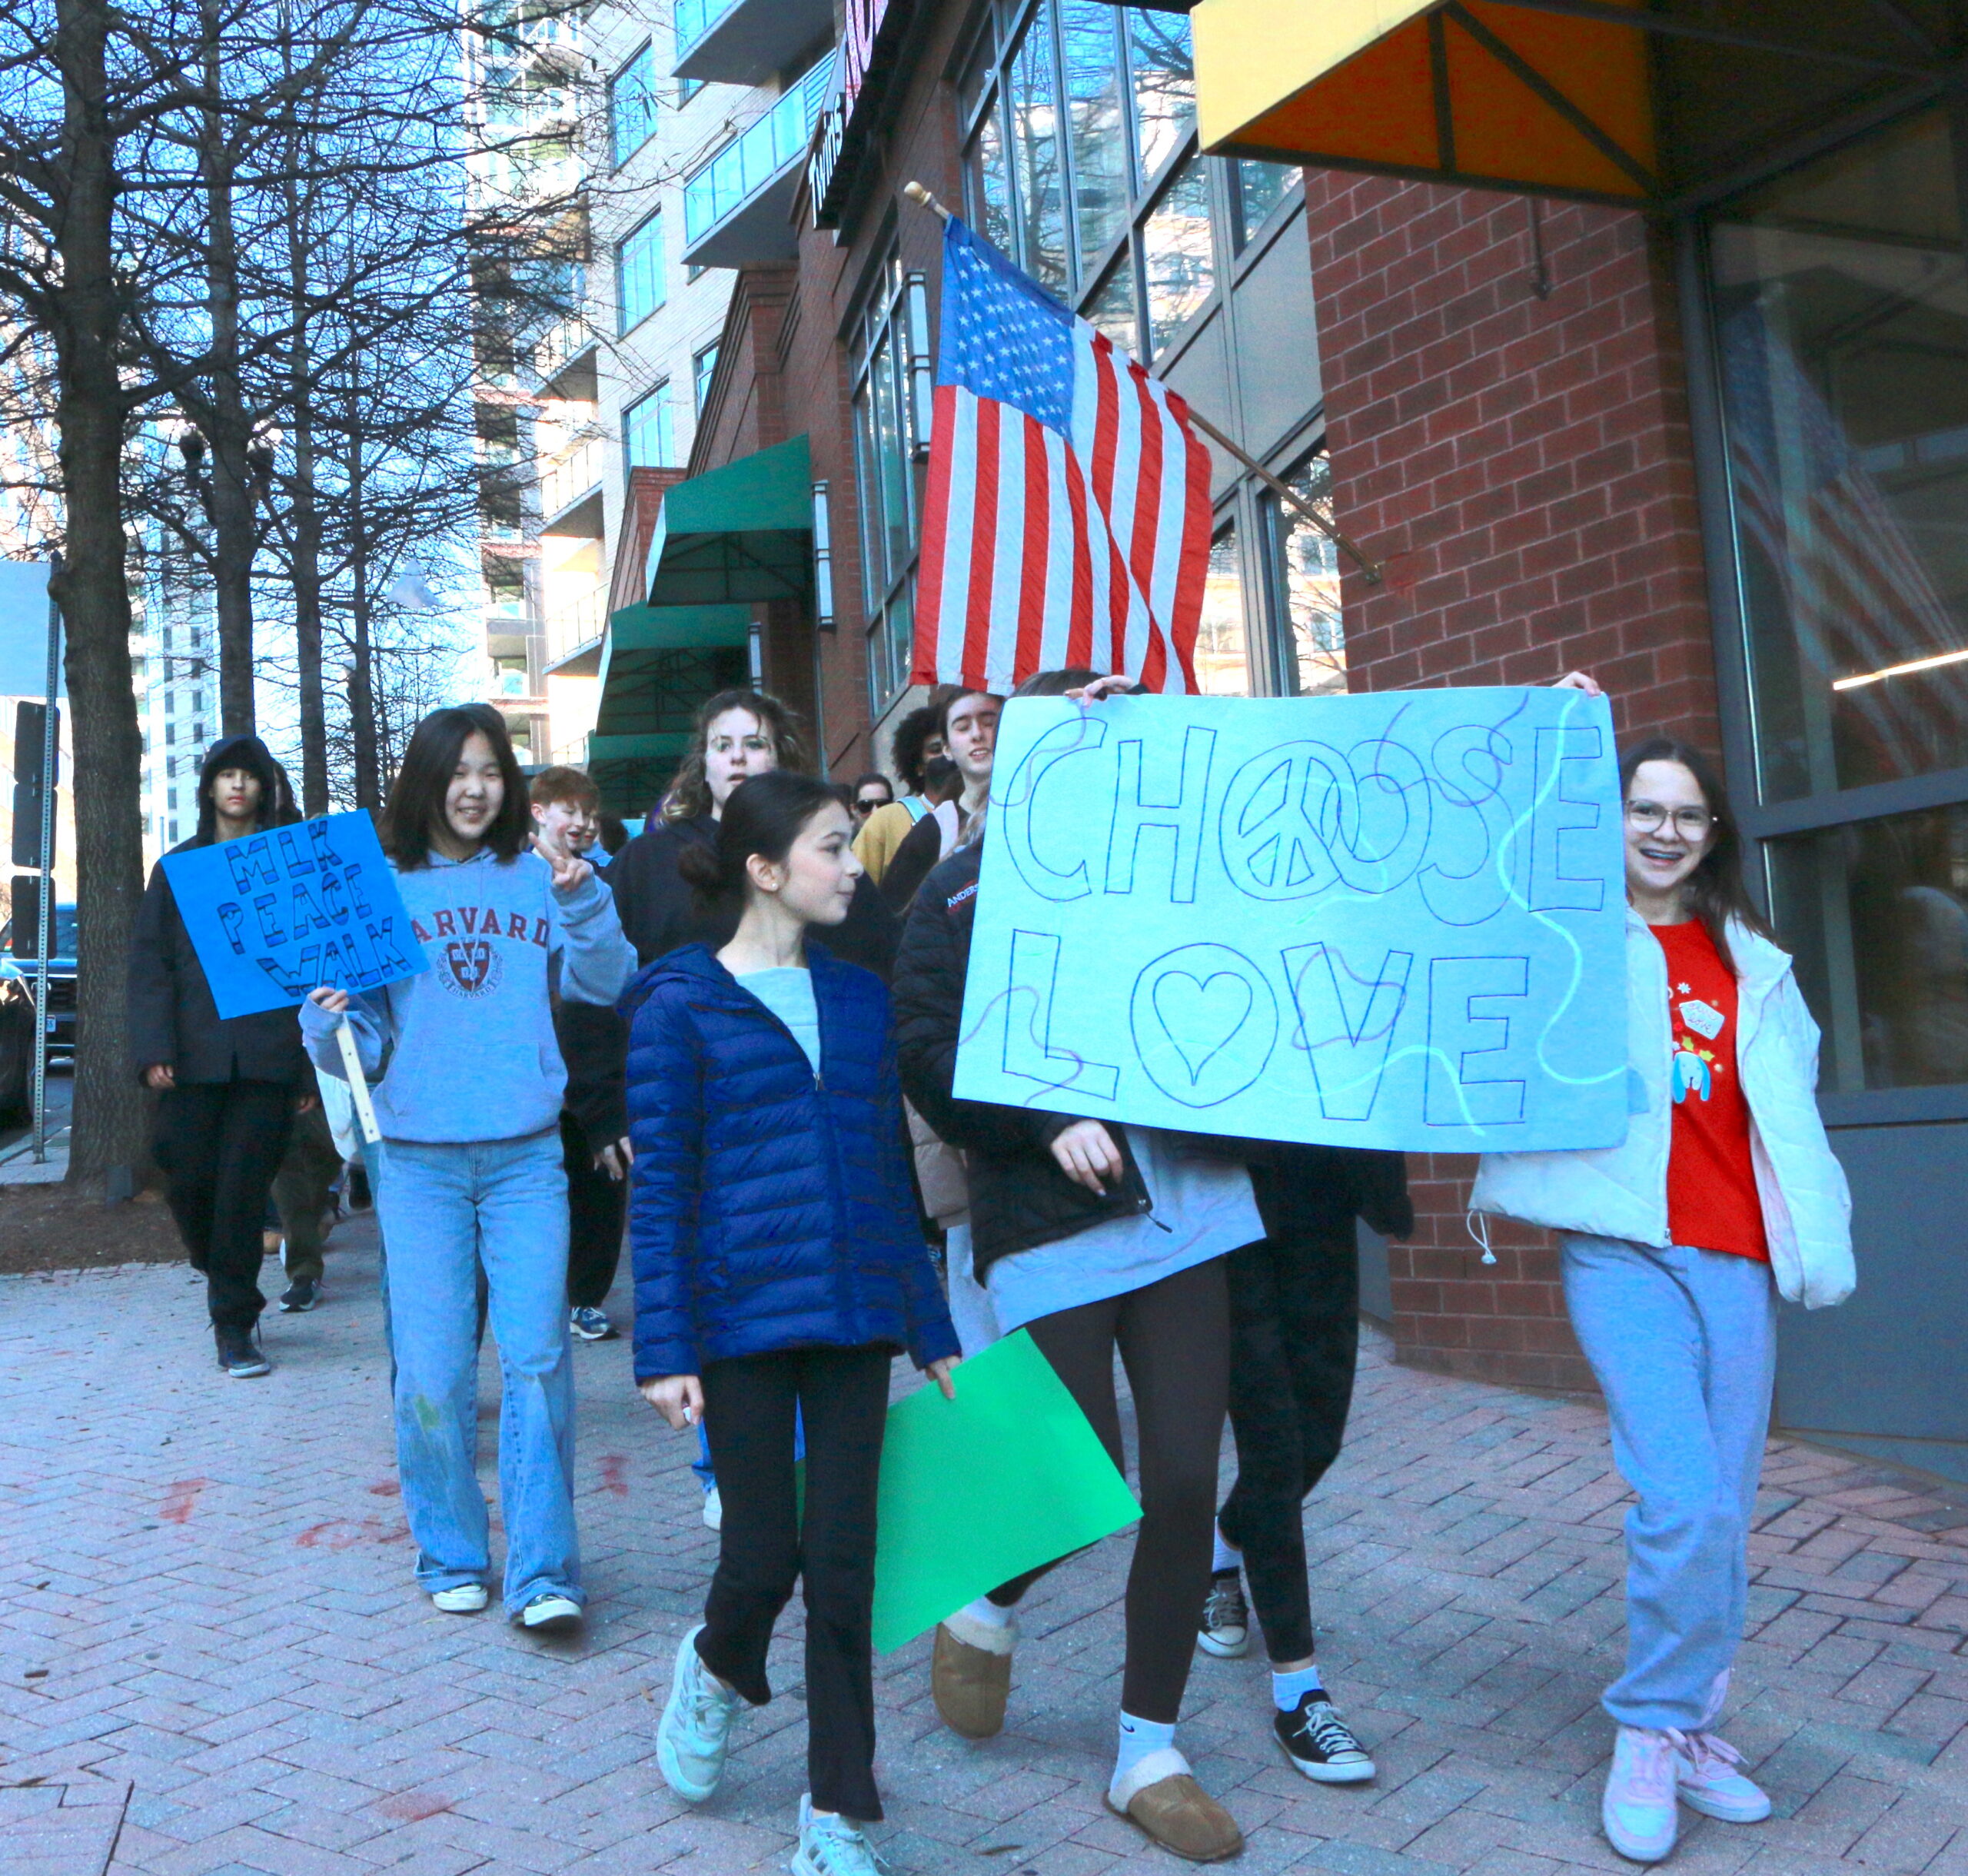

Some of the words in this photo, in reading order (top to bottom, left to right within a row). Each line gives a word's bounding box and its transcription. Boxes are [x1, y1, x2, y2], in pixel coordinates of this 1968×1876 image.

[224, 820, 344, 896] MLK
[1003, 717, 1607, 926] CHOOSE
[217, 863, 374, 955] PEACE
[255, 916, 414, 997] WALK
[1002, 928, 1531, 1126] LOVE
